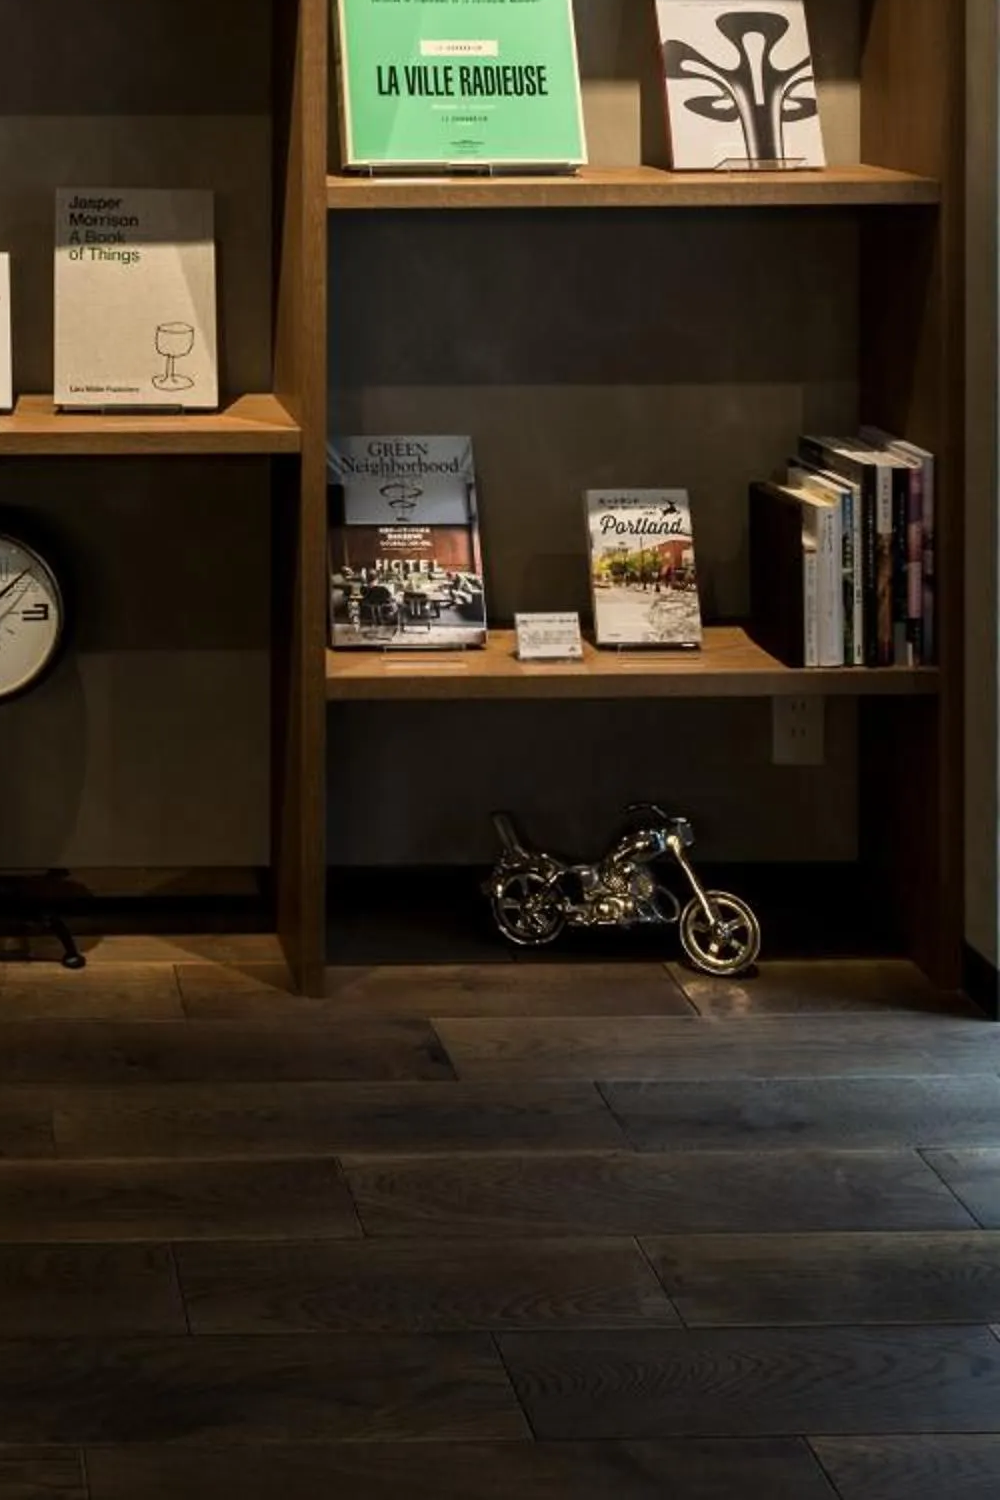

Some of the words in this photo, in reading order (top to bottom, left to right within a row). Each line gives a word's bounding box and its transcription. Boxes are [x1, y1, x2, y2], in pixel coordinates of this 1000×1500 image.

[376, 65, 400, 96] LA
[404, 65, 454, 97] VILLE
[459, 65, 548, 97] RADIEUSE
[69, 196, 122, 212] Jasper
[69, 213, 139, 227] Morrison
[70, 230, 81, 244] A
[85, 230, 126, 243] Book
[69, 247, 84, 260] of
[88, 247, 141, 264] Things
[367, 442, 429, 456] GREEN
[341, 457, 460, 476] Neighborhood
[600, 515, 683, 535] Portland
[375, 559, 444, 574] HOTEL
[22, 604, 49, 621] 3
